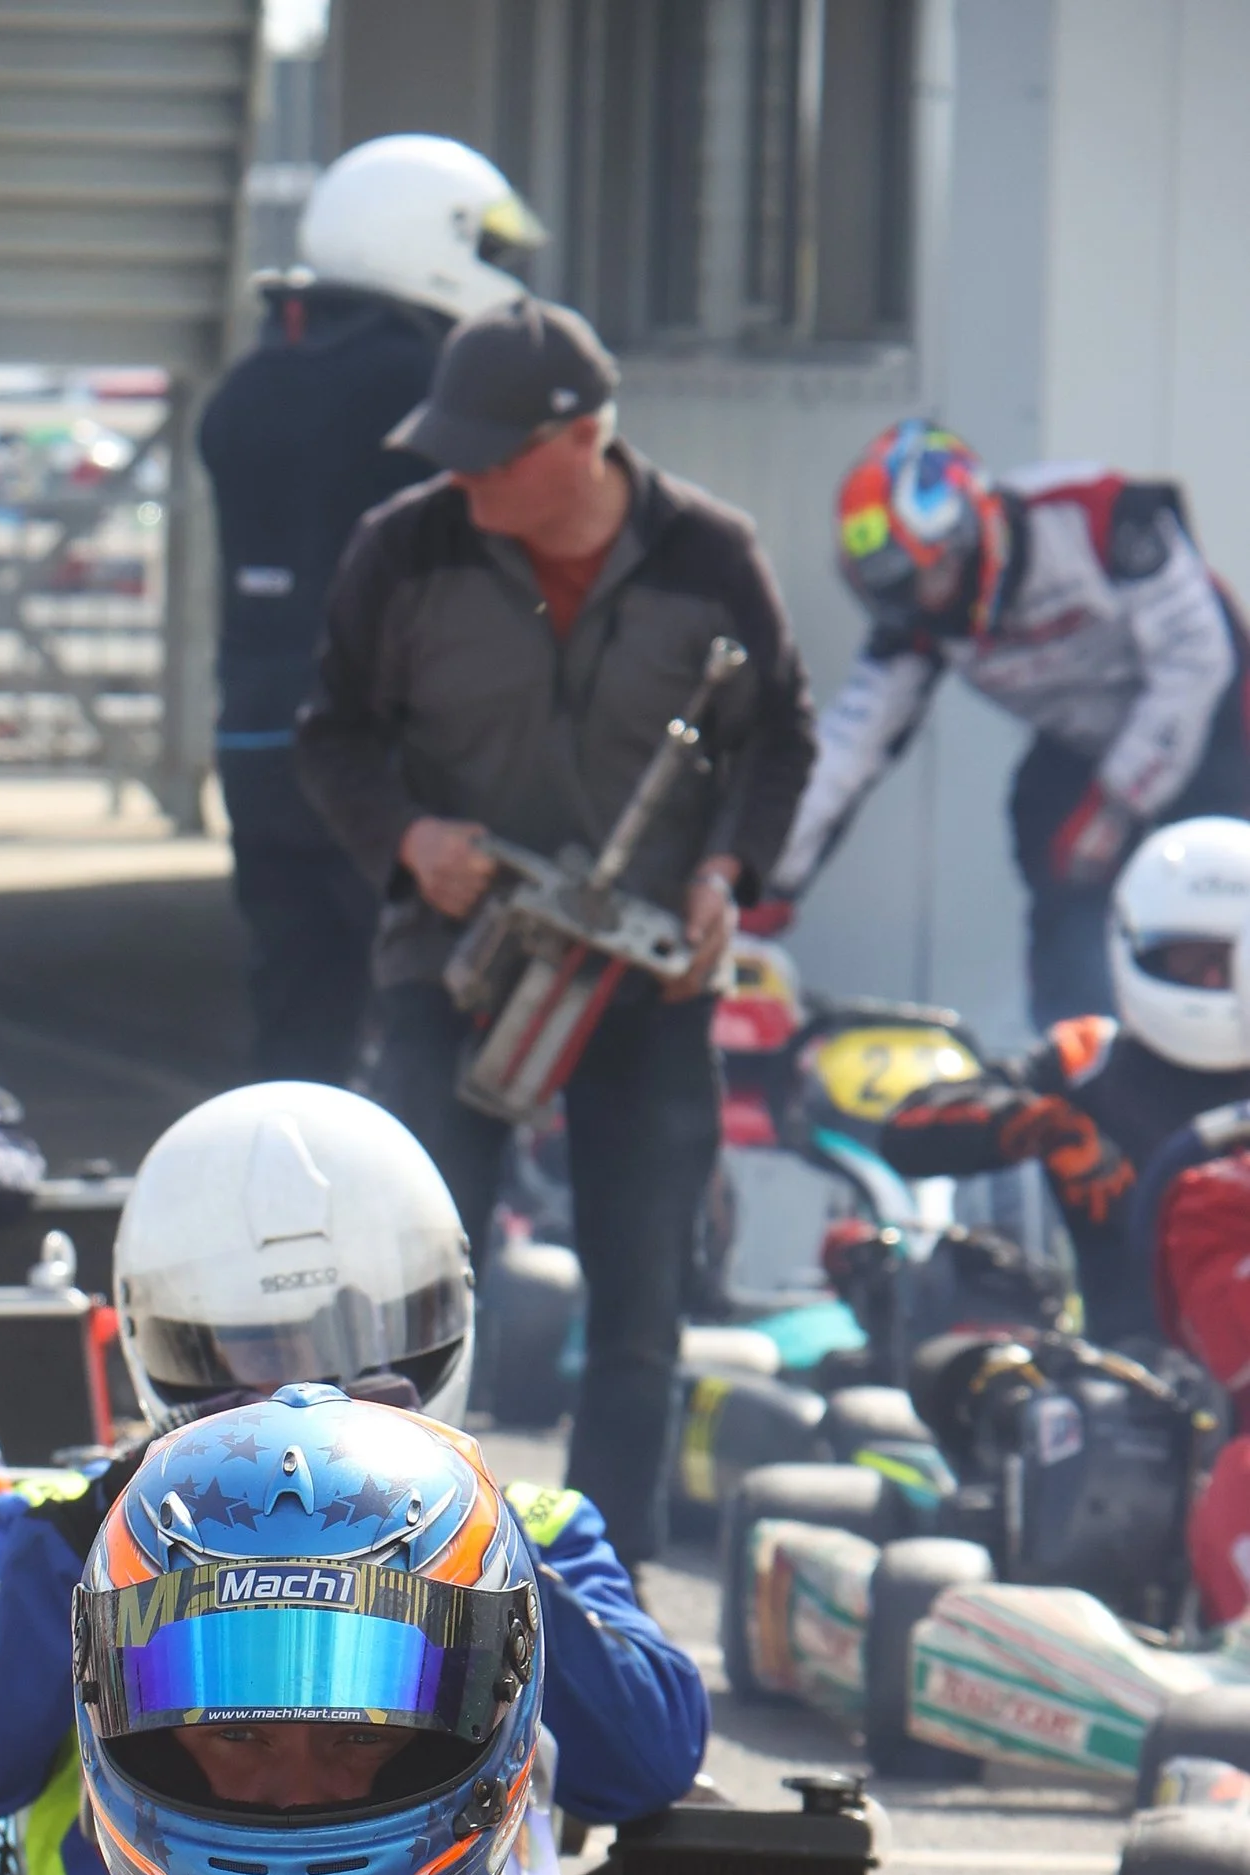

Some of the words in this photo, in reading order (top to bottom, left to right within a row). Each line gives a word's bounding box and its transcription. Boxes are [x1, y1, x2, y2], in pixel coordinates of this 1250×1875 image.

[261, 1266, 338, 1294] sparco
[220, 1568, 353, 1603] Mach1
[207, 1707, 361, 1721] www.mach1kart.com
